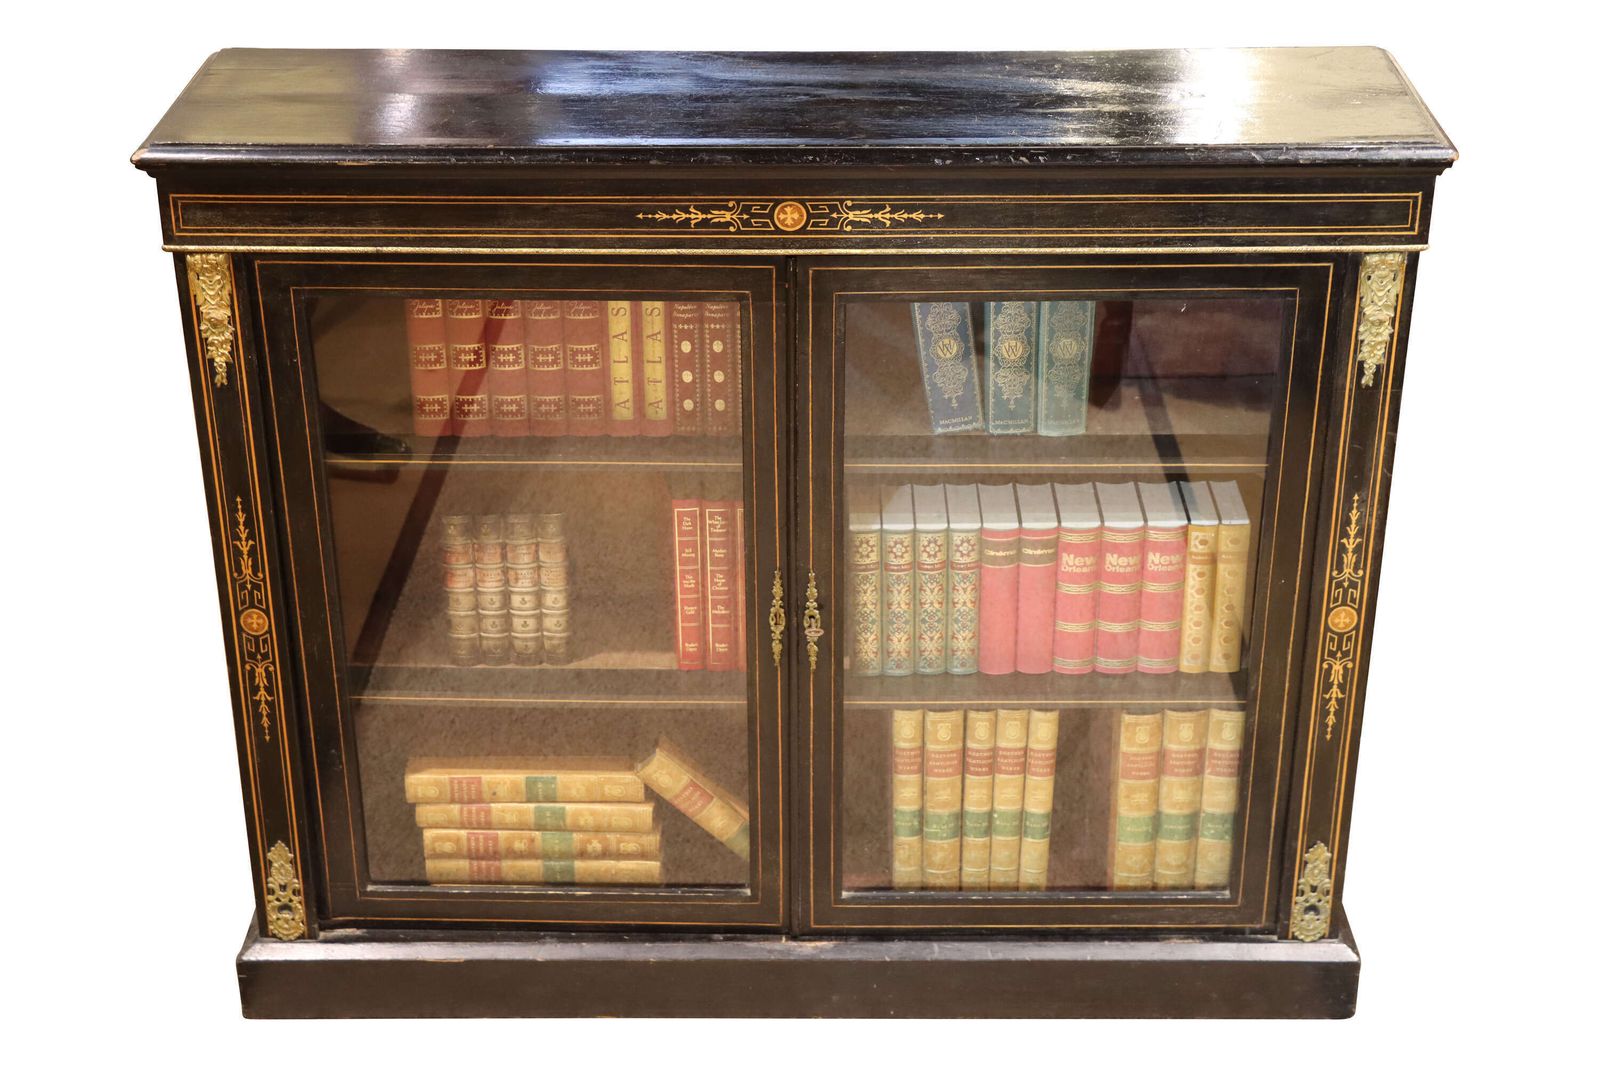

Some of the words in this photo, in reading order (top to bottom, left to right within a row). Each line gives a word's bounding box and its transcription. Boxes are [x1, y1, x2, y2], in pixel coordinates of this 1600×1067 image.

[611, 306, 630, 410] ATLAS
[645, 306, 663, 410] ATLAS
[940, 415, 973, 425] MACMILLAN
[1061, 552, 1098, 566] New
[1105, 552, 1142, 566] New
[1147, 551, 1184, 565] New
[1060, 564, 1097, 573] Orlean
[1104, 563, 1140, 573] Orlean
